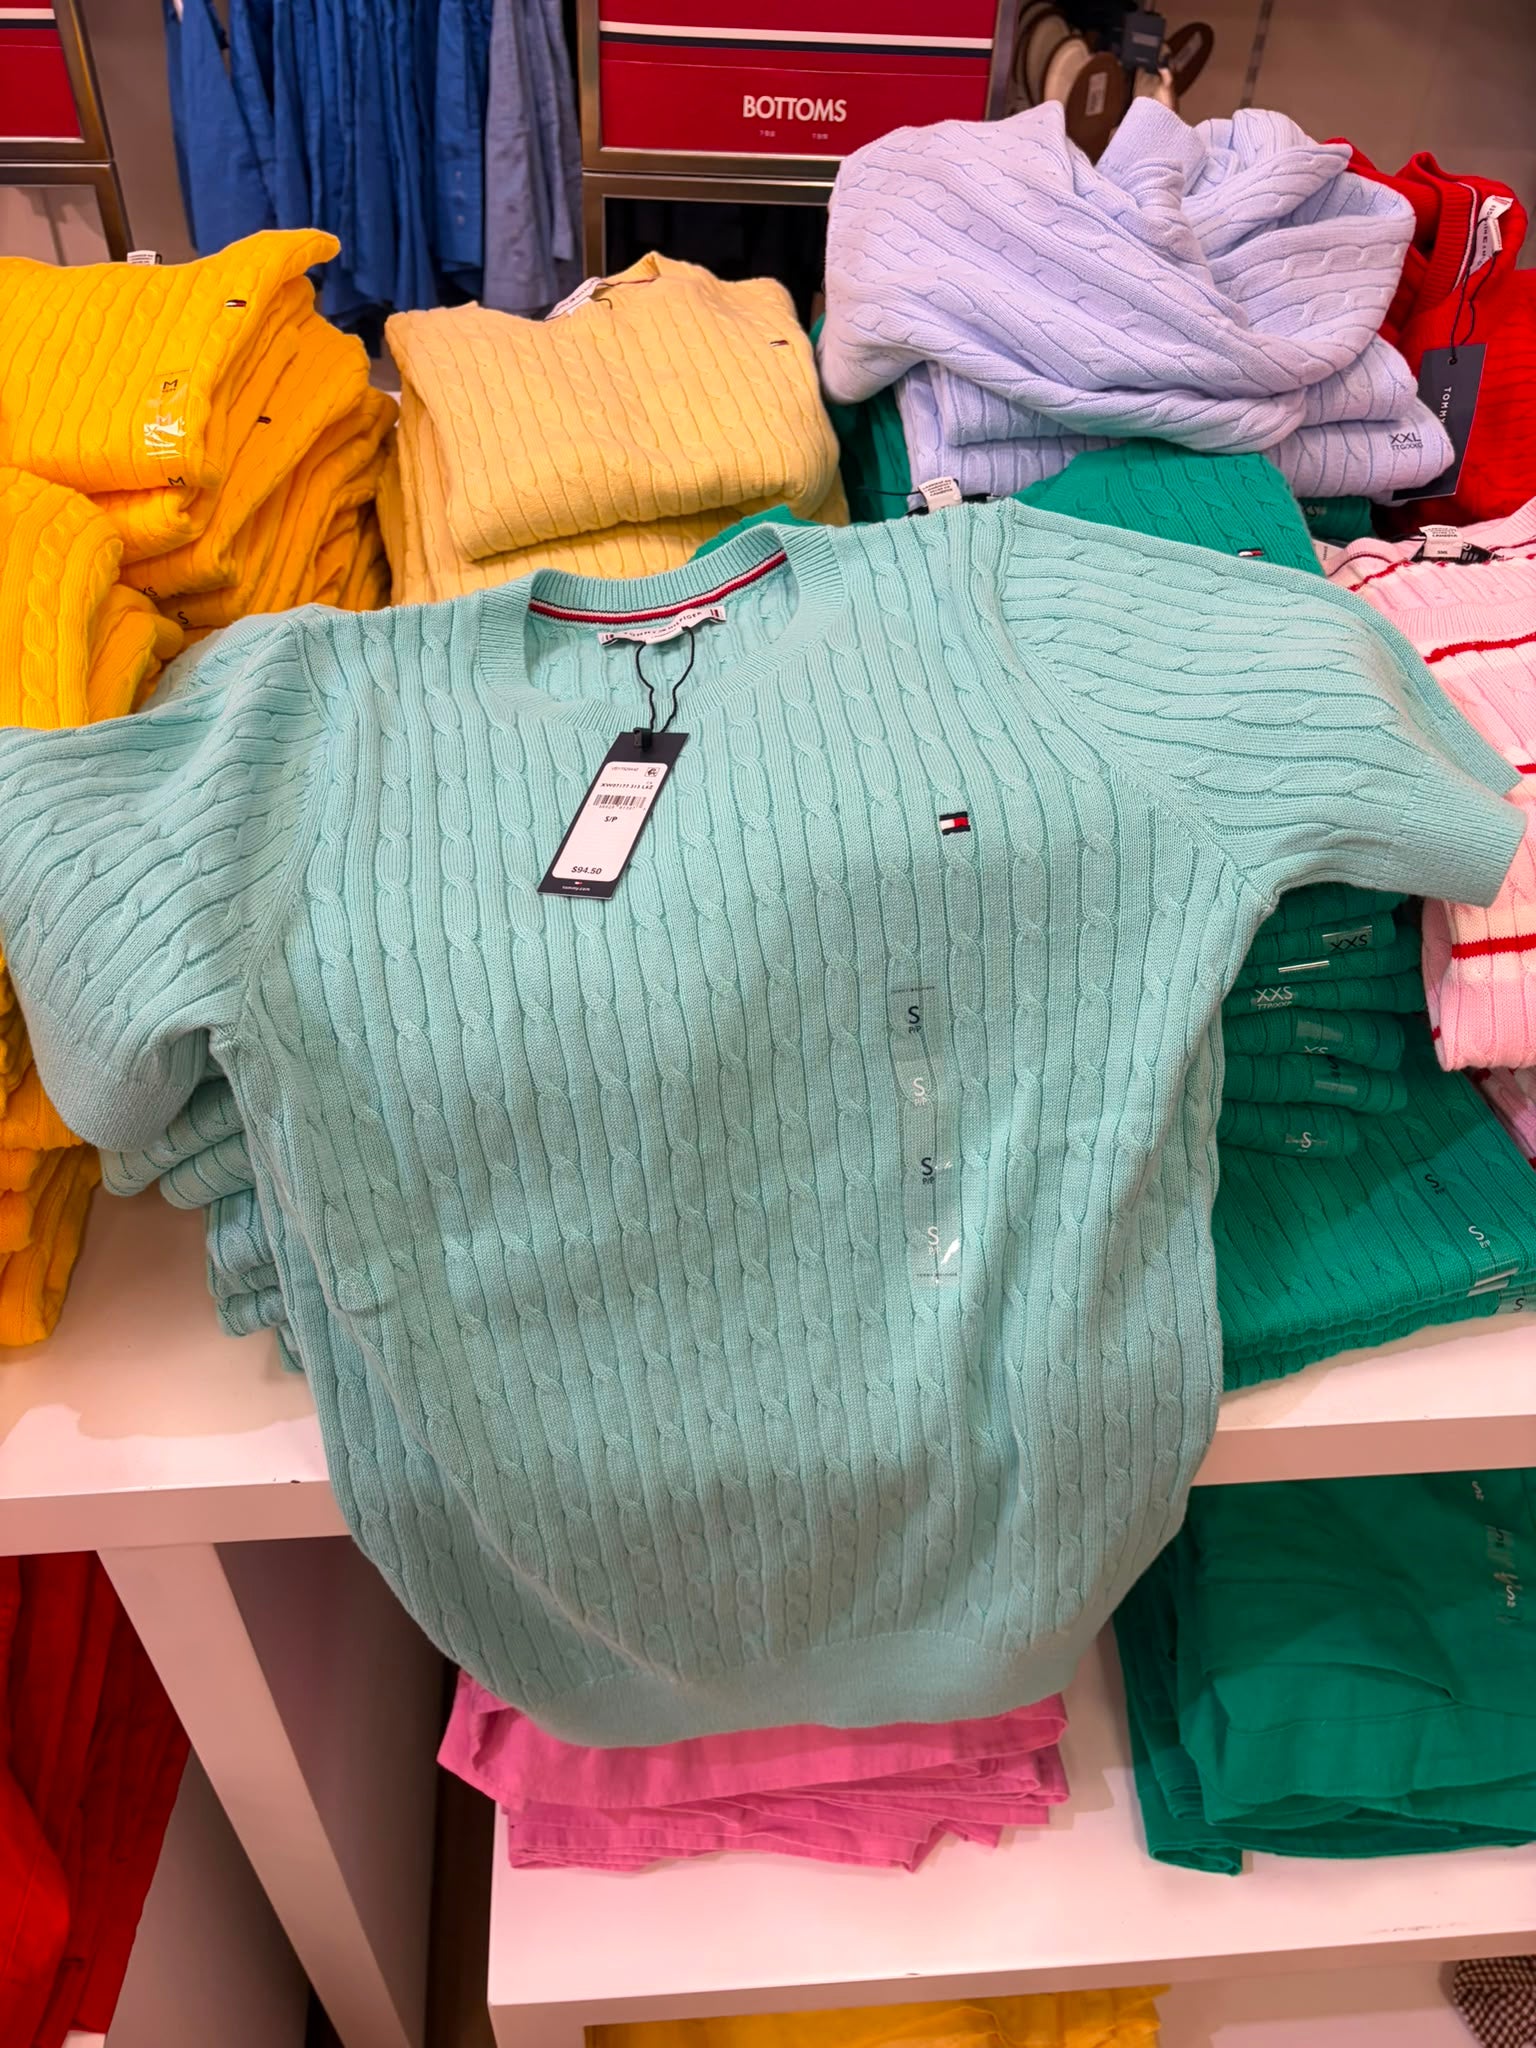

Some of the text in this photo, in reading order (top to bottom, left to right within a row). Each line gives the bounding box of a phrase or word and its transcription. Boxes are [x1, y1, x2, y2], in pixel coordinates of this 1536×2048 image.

[742, 94, 847, 122] BOTTOMS
[163, 379, 178, 389] M
[1439, 386, 1452, 423] TOMMY
[1390, 432, 1422, 444] XXL
[177, 611, 189, 625] S
[604, 815, 618, 823] S/P
[571, 865, 602, 875] $94.50
[1331, 934, 1368, 953] XXS
[1255, 986, 1293, 1003] XXS
[908, 1005, 920, 1025] S
[912, 1077, 926, 1097] S
[1301, 1131, 1312, 1149] S
[921, 1156, 933, 1176] S
[1424, 1173, 1439, 1189] S
[927, 1225, 940, 1246] S
[1468, 1225, 1485, 1241] S
[1513, 1297, 1525, 1311] S
[1506, 1584, 1516, 1601] S
